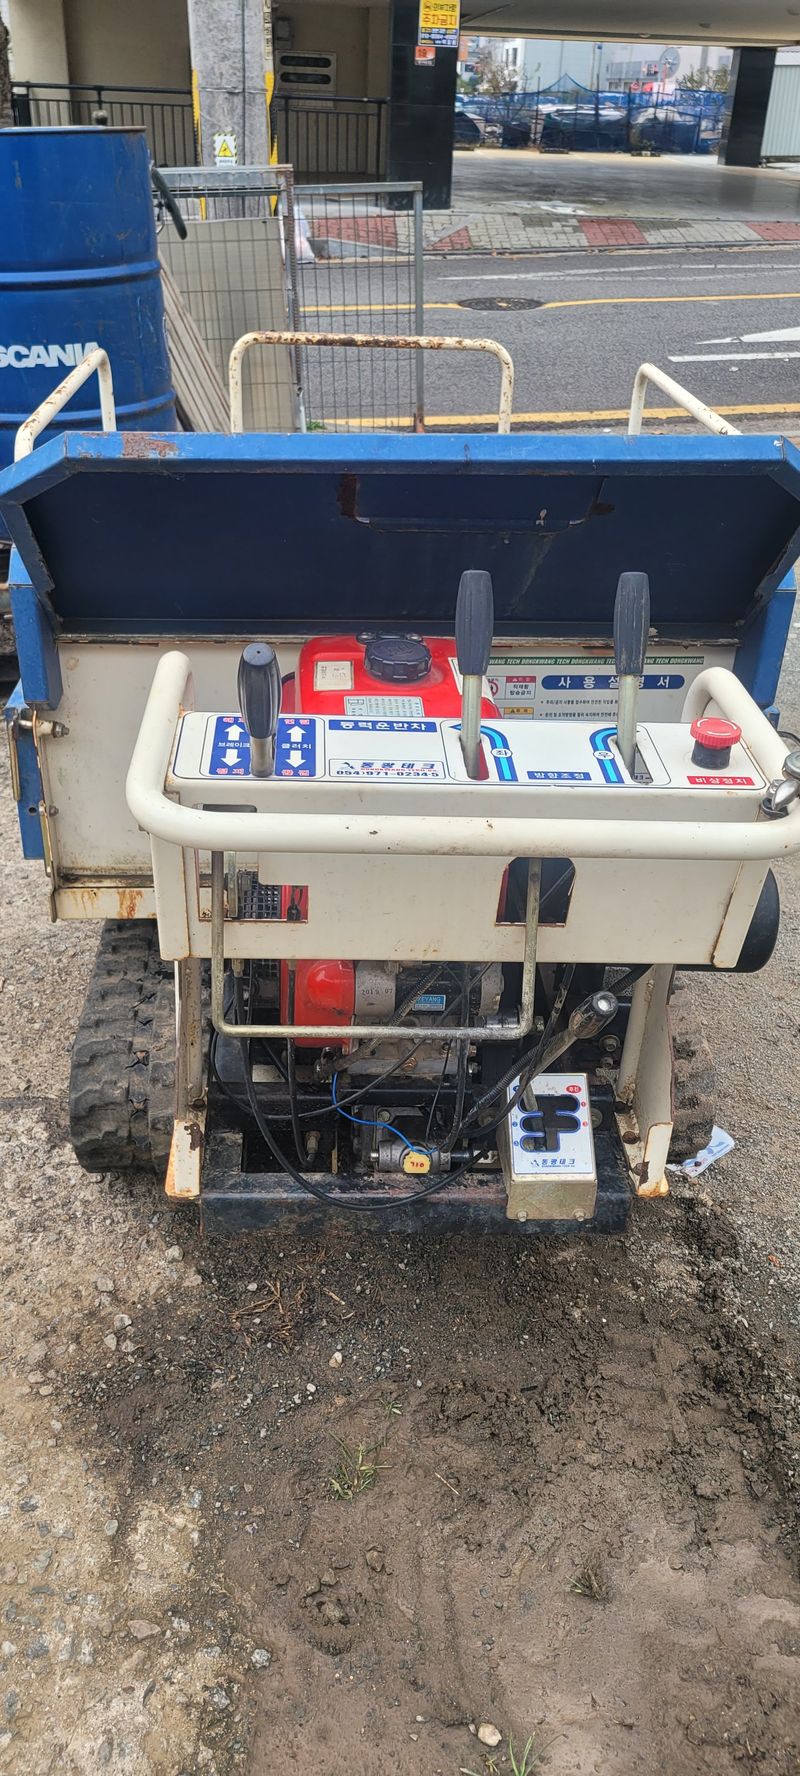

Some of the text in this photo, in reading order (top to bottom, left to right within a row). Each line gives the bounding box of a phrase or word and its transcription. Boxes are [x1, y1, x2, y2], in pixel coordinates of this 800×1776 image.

[423, 13, 457, 26] 주차금지
[340, 721, 427, 731] 동력운반차
[496, 749, 508, 757] 좌
[695, 777, 747, 785] 비상정지
